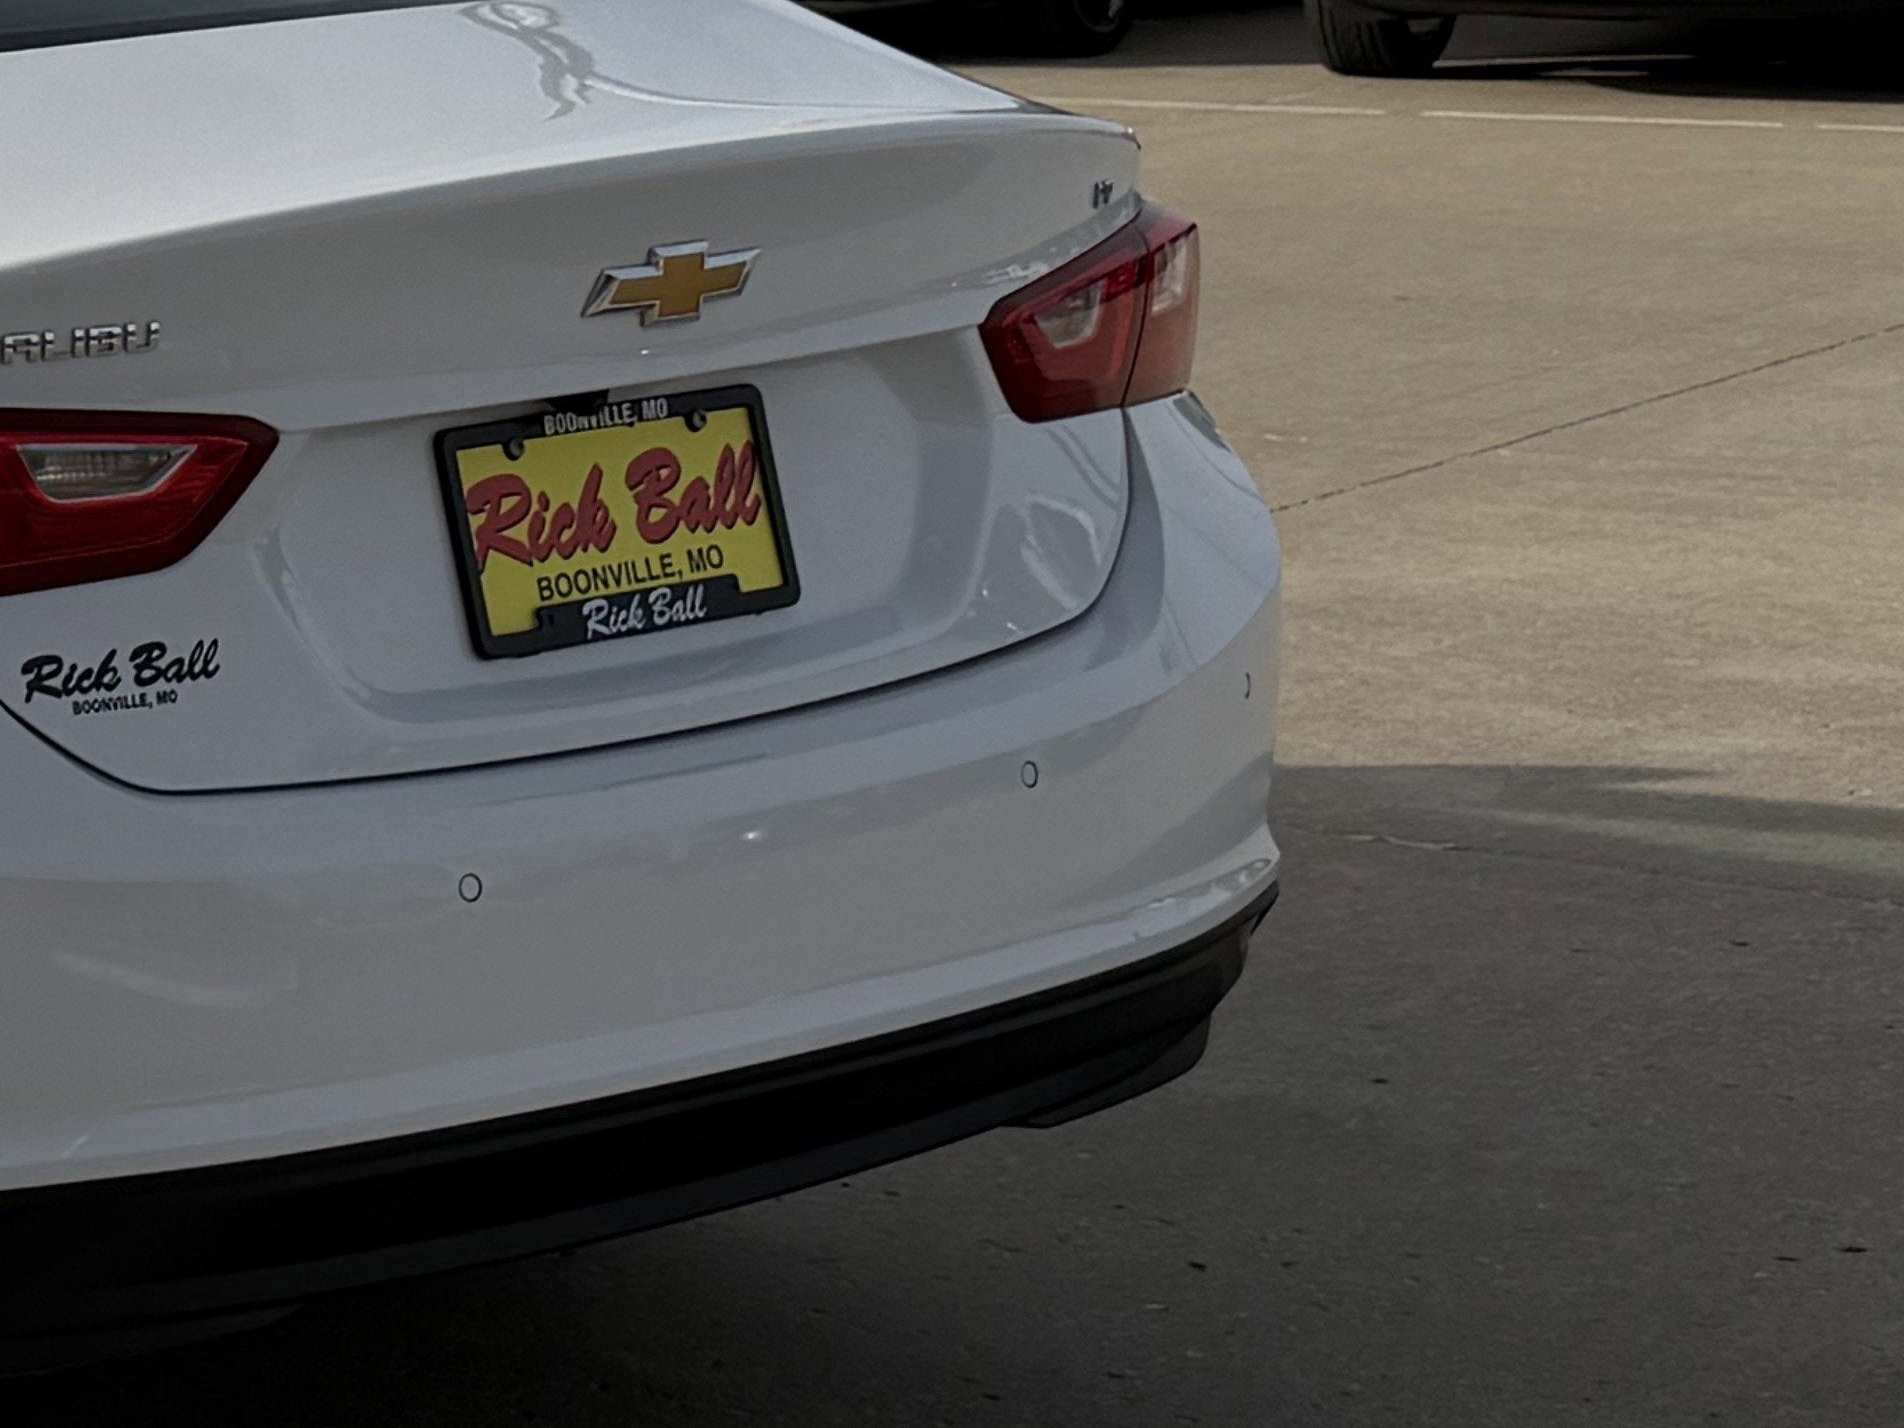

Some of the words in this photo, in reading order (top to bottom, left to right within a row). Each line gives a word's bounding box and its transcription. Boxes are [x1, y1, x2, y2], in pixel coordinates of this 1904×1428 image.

[643, 397, 669, 419] MO
[465, 462, 617, 575] Rick
[624, 440, 762, 545] Ball
[537, 552, 683, 601] BOONVILLE,
[687, 543, 724, 573] MO
[582, 589, 647, 639] Rick
[648, 585, 708, 625] Ball
[20, 648, 122, 704] Rick
[129, 637, 221, 688] Ball
[72, 691, 153, 716] BOONVILLE,
[156, 689, 179, 706] MO
